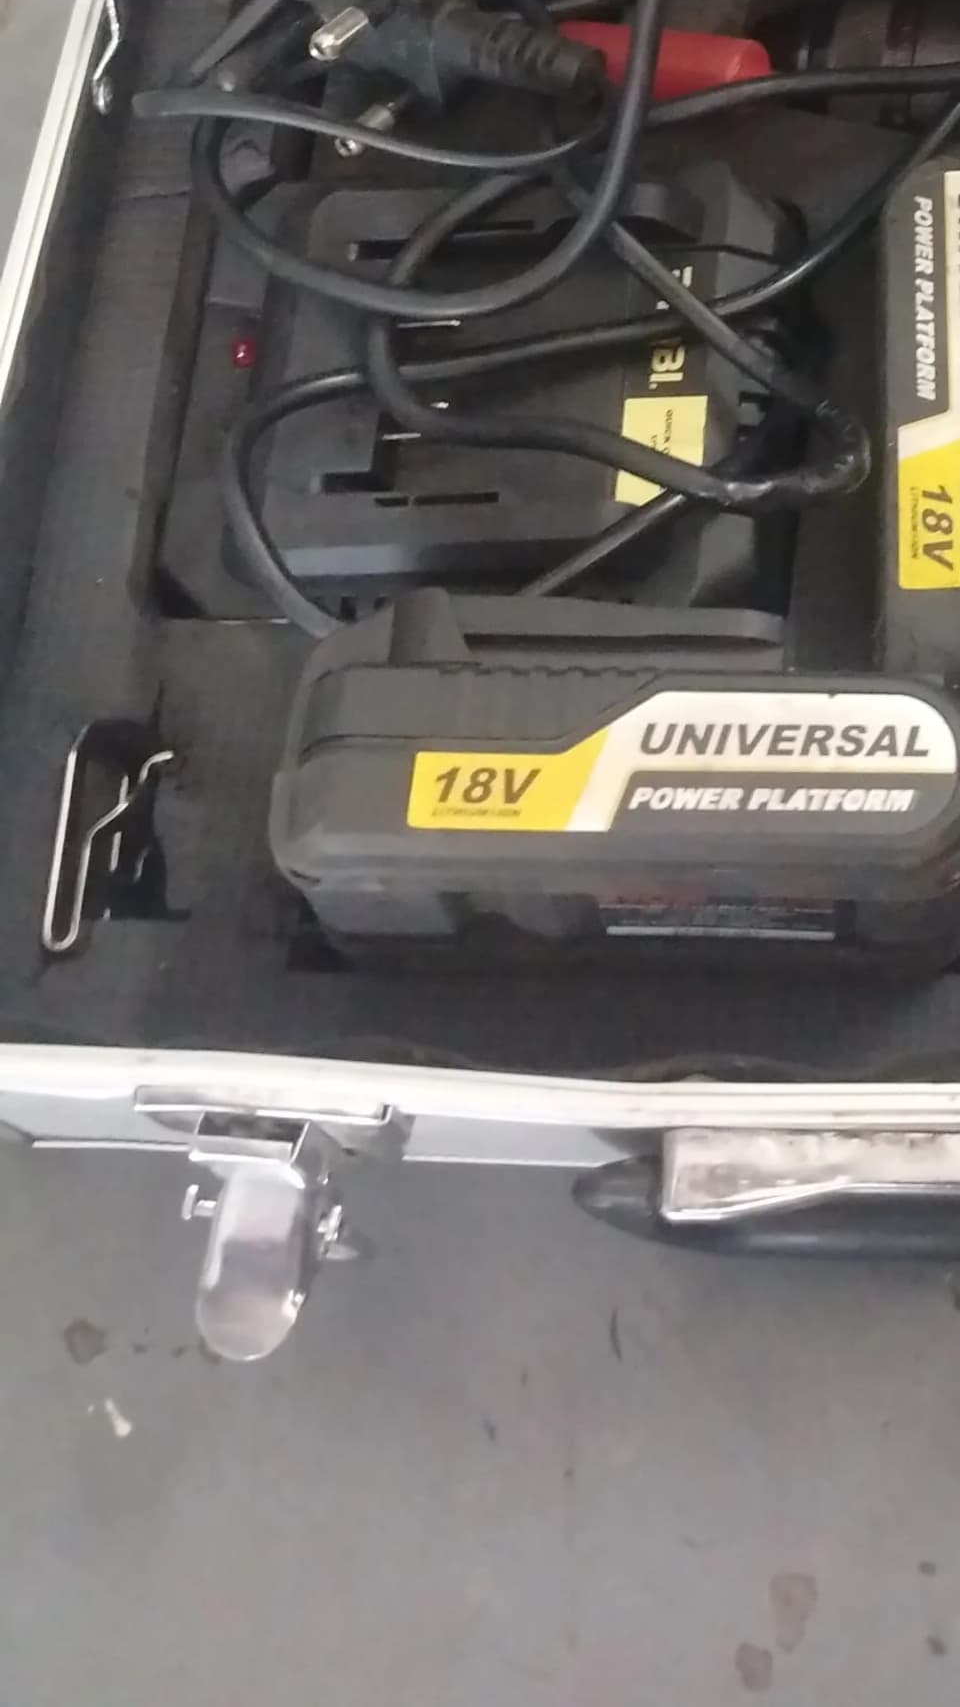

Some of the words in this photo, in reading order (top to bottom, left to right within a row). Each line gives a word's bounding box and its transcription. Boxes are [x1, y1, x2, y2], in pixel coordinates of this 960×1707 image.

[913, 195, 934, 278] POWER
[914, 279, 936, 401] PLATFORM
[921, 484, 954, 571] 18V
[639, 723, 930, 758] UNIVERSAL
[433, 766, 540, 804] 18V
[628, 787, 743, 811] POWER
[749, 788, 915, 813] PLATFORM
